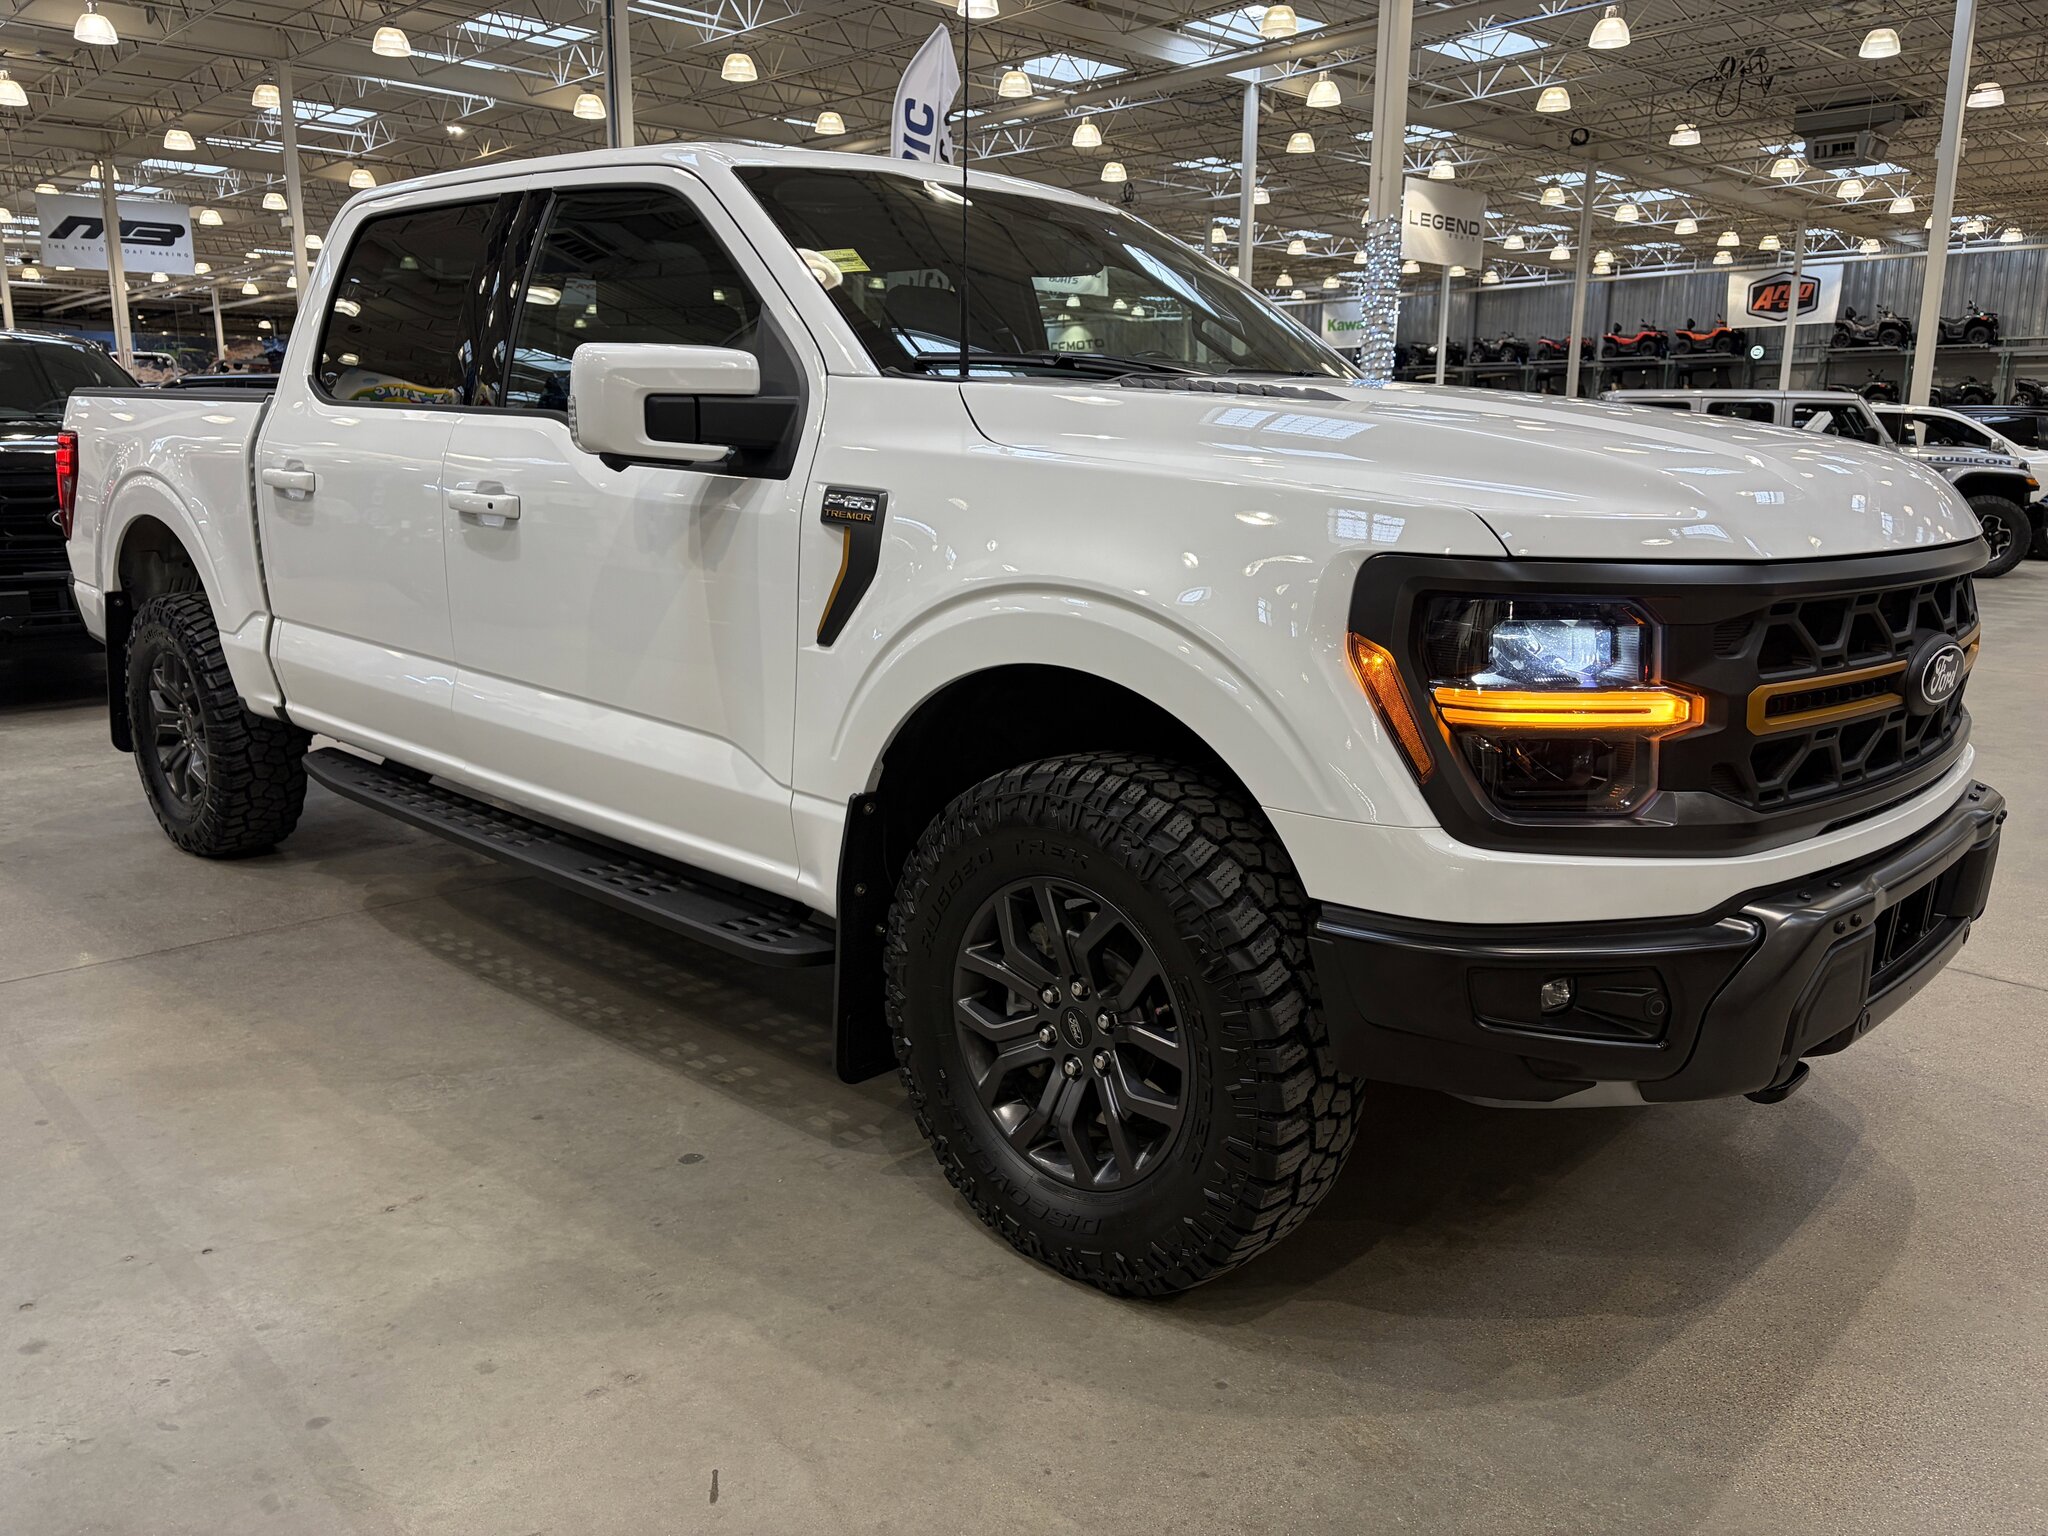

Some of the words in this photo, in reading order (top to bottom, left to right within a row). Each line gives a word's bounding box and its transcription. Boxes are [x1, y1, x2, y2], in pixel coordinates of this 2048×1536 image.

[1409, 209, 1480, 236] LEGEND
[1327, 318, 1364, 332] Kawa
[1927, 456, 2012, 466] RUBICON
[823, 508, 873, 522] TREMOR
[1930, 653, 1960, 696] Ford
